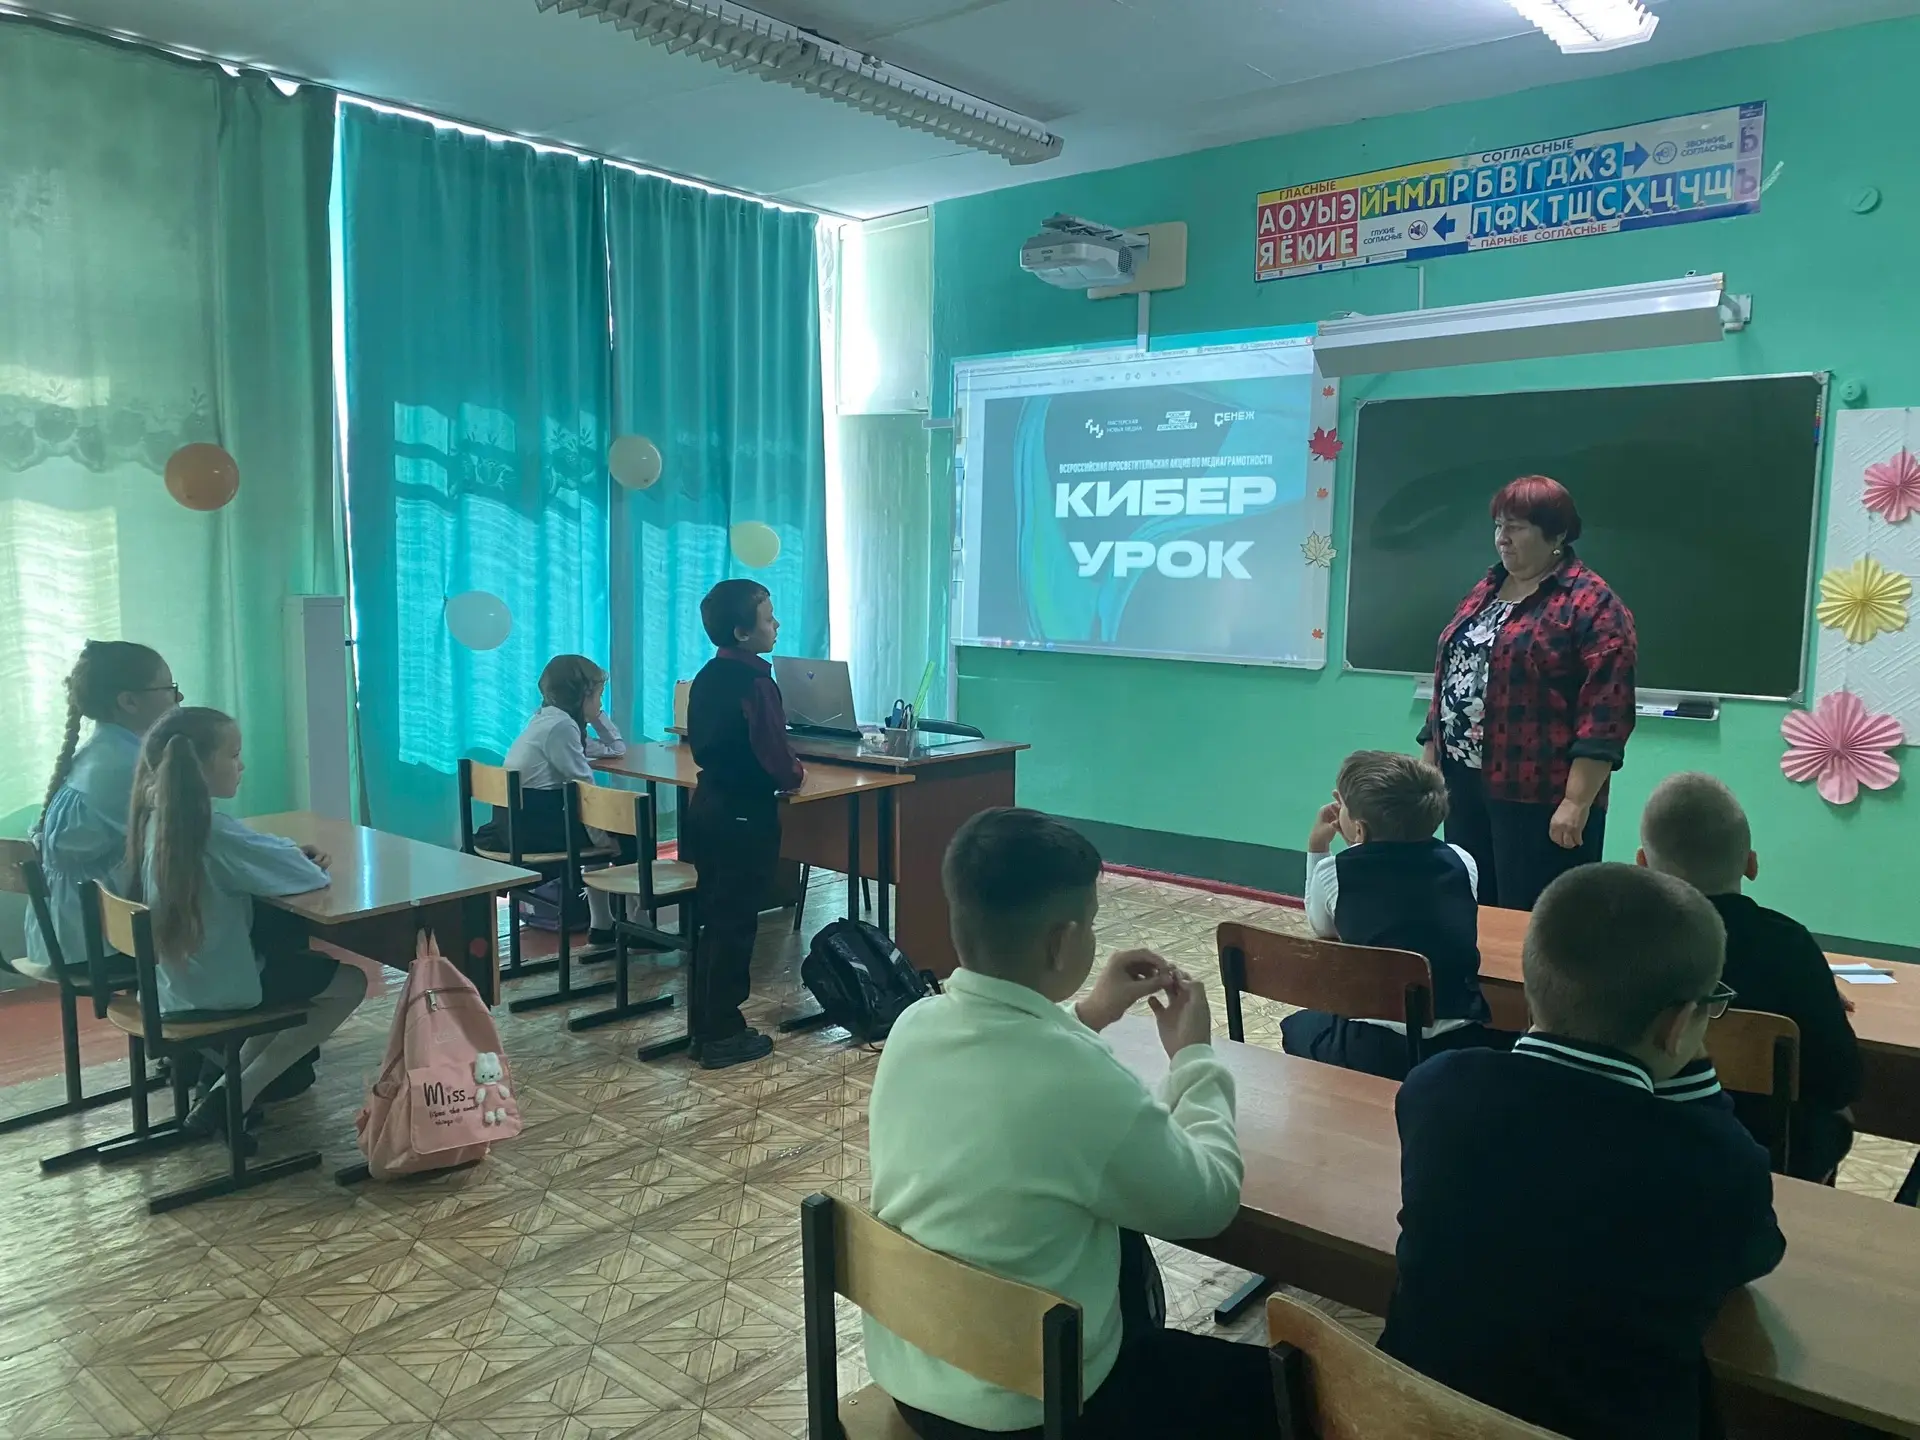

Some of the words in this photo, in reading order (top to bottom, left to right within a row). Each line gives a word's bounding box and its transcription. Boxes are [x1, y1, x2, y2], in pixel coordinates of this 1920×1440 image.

[1482, 138, 1574, 163] СОГЛАСНЫЕ
[1681, 142, 1734, 157] СОГЛАСНЫЕ
[1685, 135, 1726, 149] ЗВОНКИЕ
[1279, 181, 1337, 200] ГЛАСНЫЕ
[1363, 232, 1403, 245] СОГЛАСНЫЕ
[1371, 227, 1395, 236] ГЛУХИЕ
[1481, 233, 1528, 248] ПАРНЫЕ
[1534, 223, 1607, 241] СОГЛАСНЫЕ
[1214, 411, 1255, 427] СЕНЕЖ
[1201, 454, 1273, 468] МЕДИАГРАМОТНОСТИ
[1055, 476, 1277, 518] КИБЕР
[1068, 540, 1255, 580] УРОК
[424, 1082, 465, 1106] Miss
